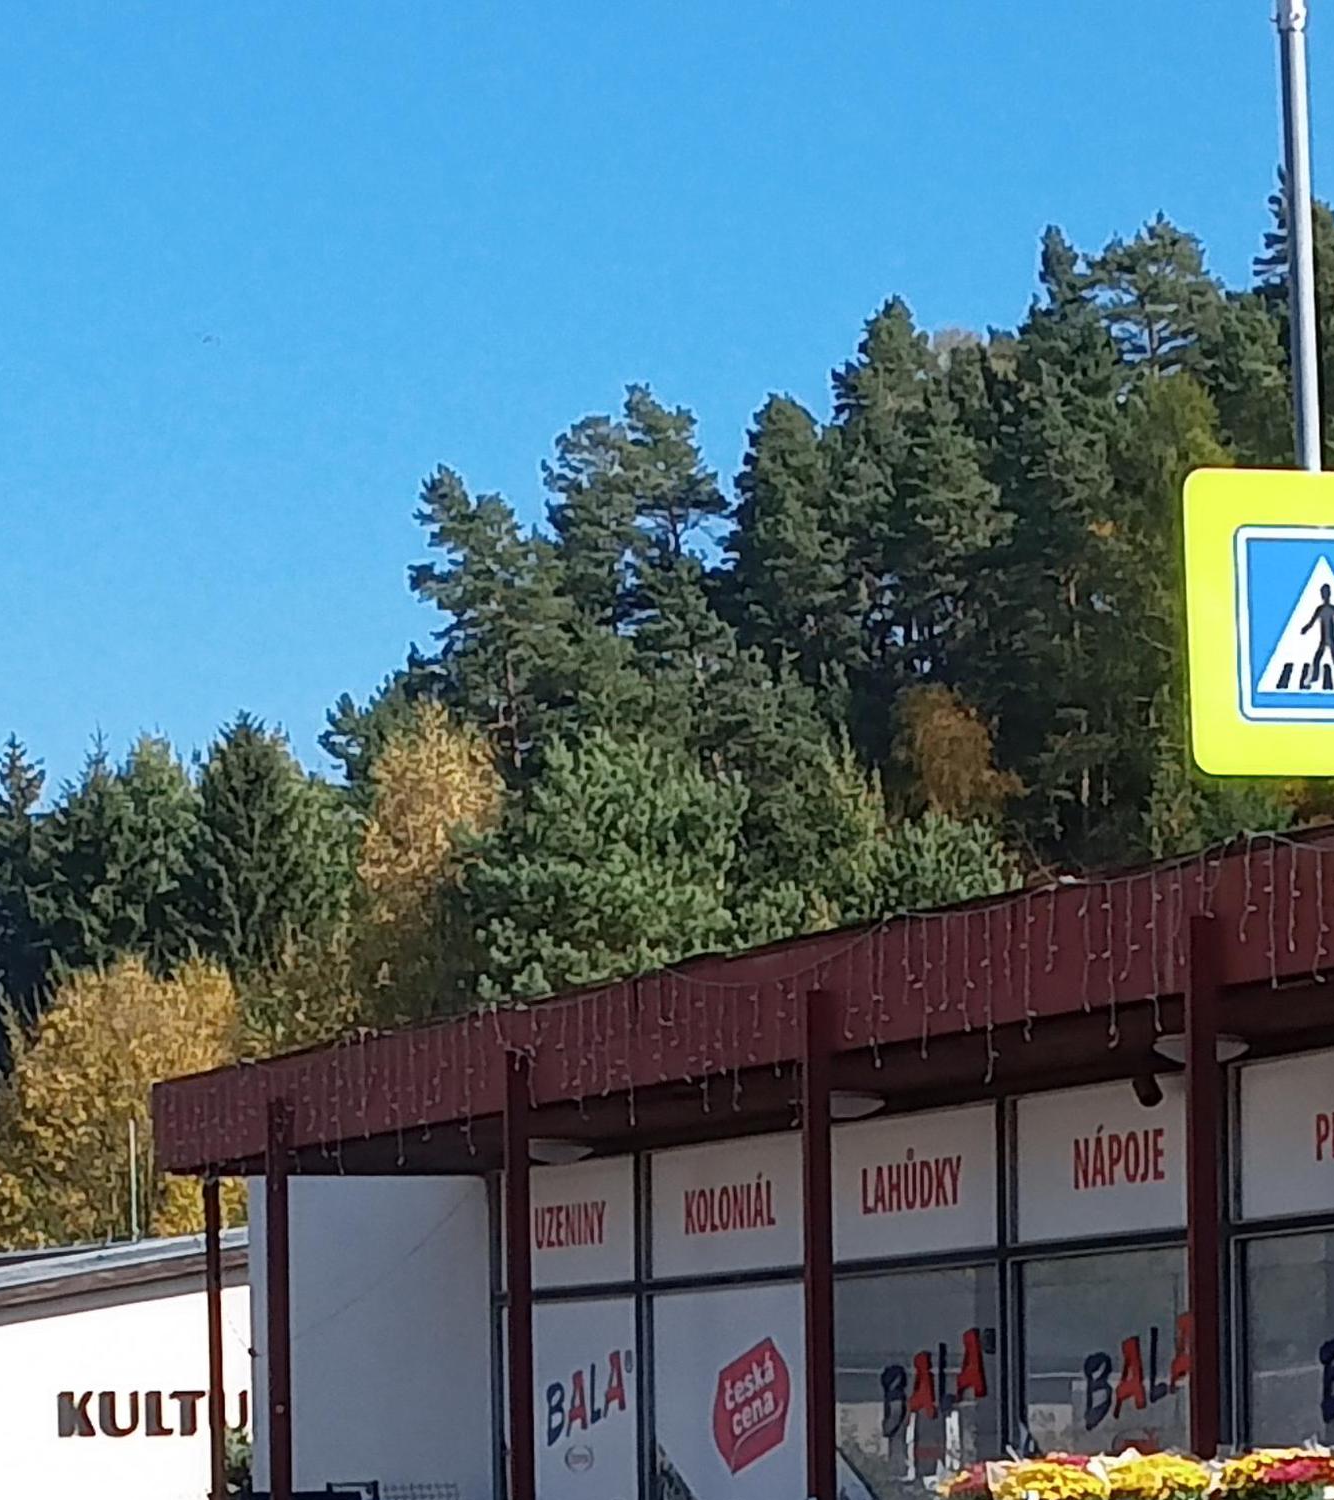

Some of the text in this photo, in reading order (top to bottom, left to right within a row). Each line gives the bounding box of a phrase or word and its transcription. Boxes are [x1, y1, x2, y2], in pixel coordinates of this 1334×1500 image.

[861, 1147, 962, 1215] LAHŮDKY
[1073, 1124, 1165, 1190] NÁPOJE
[534, 1200, 606, 1250] UZENINY
[683, 1171, 776, 1236] KOLONIÁL
[724, 1352, 775, 1411] česká
[732, 1391, 775, 1437] cena
